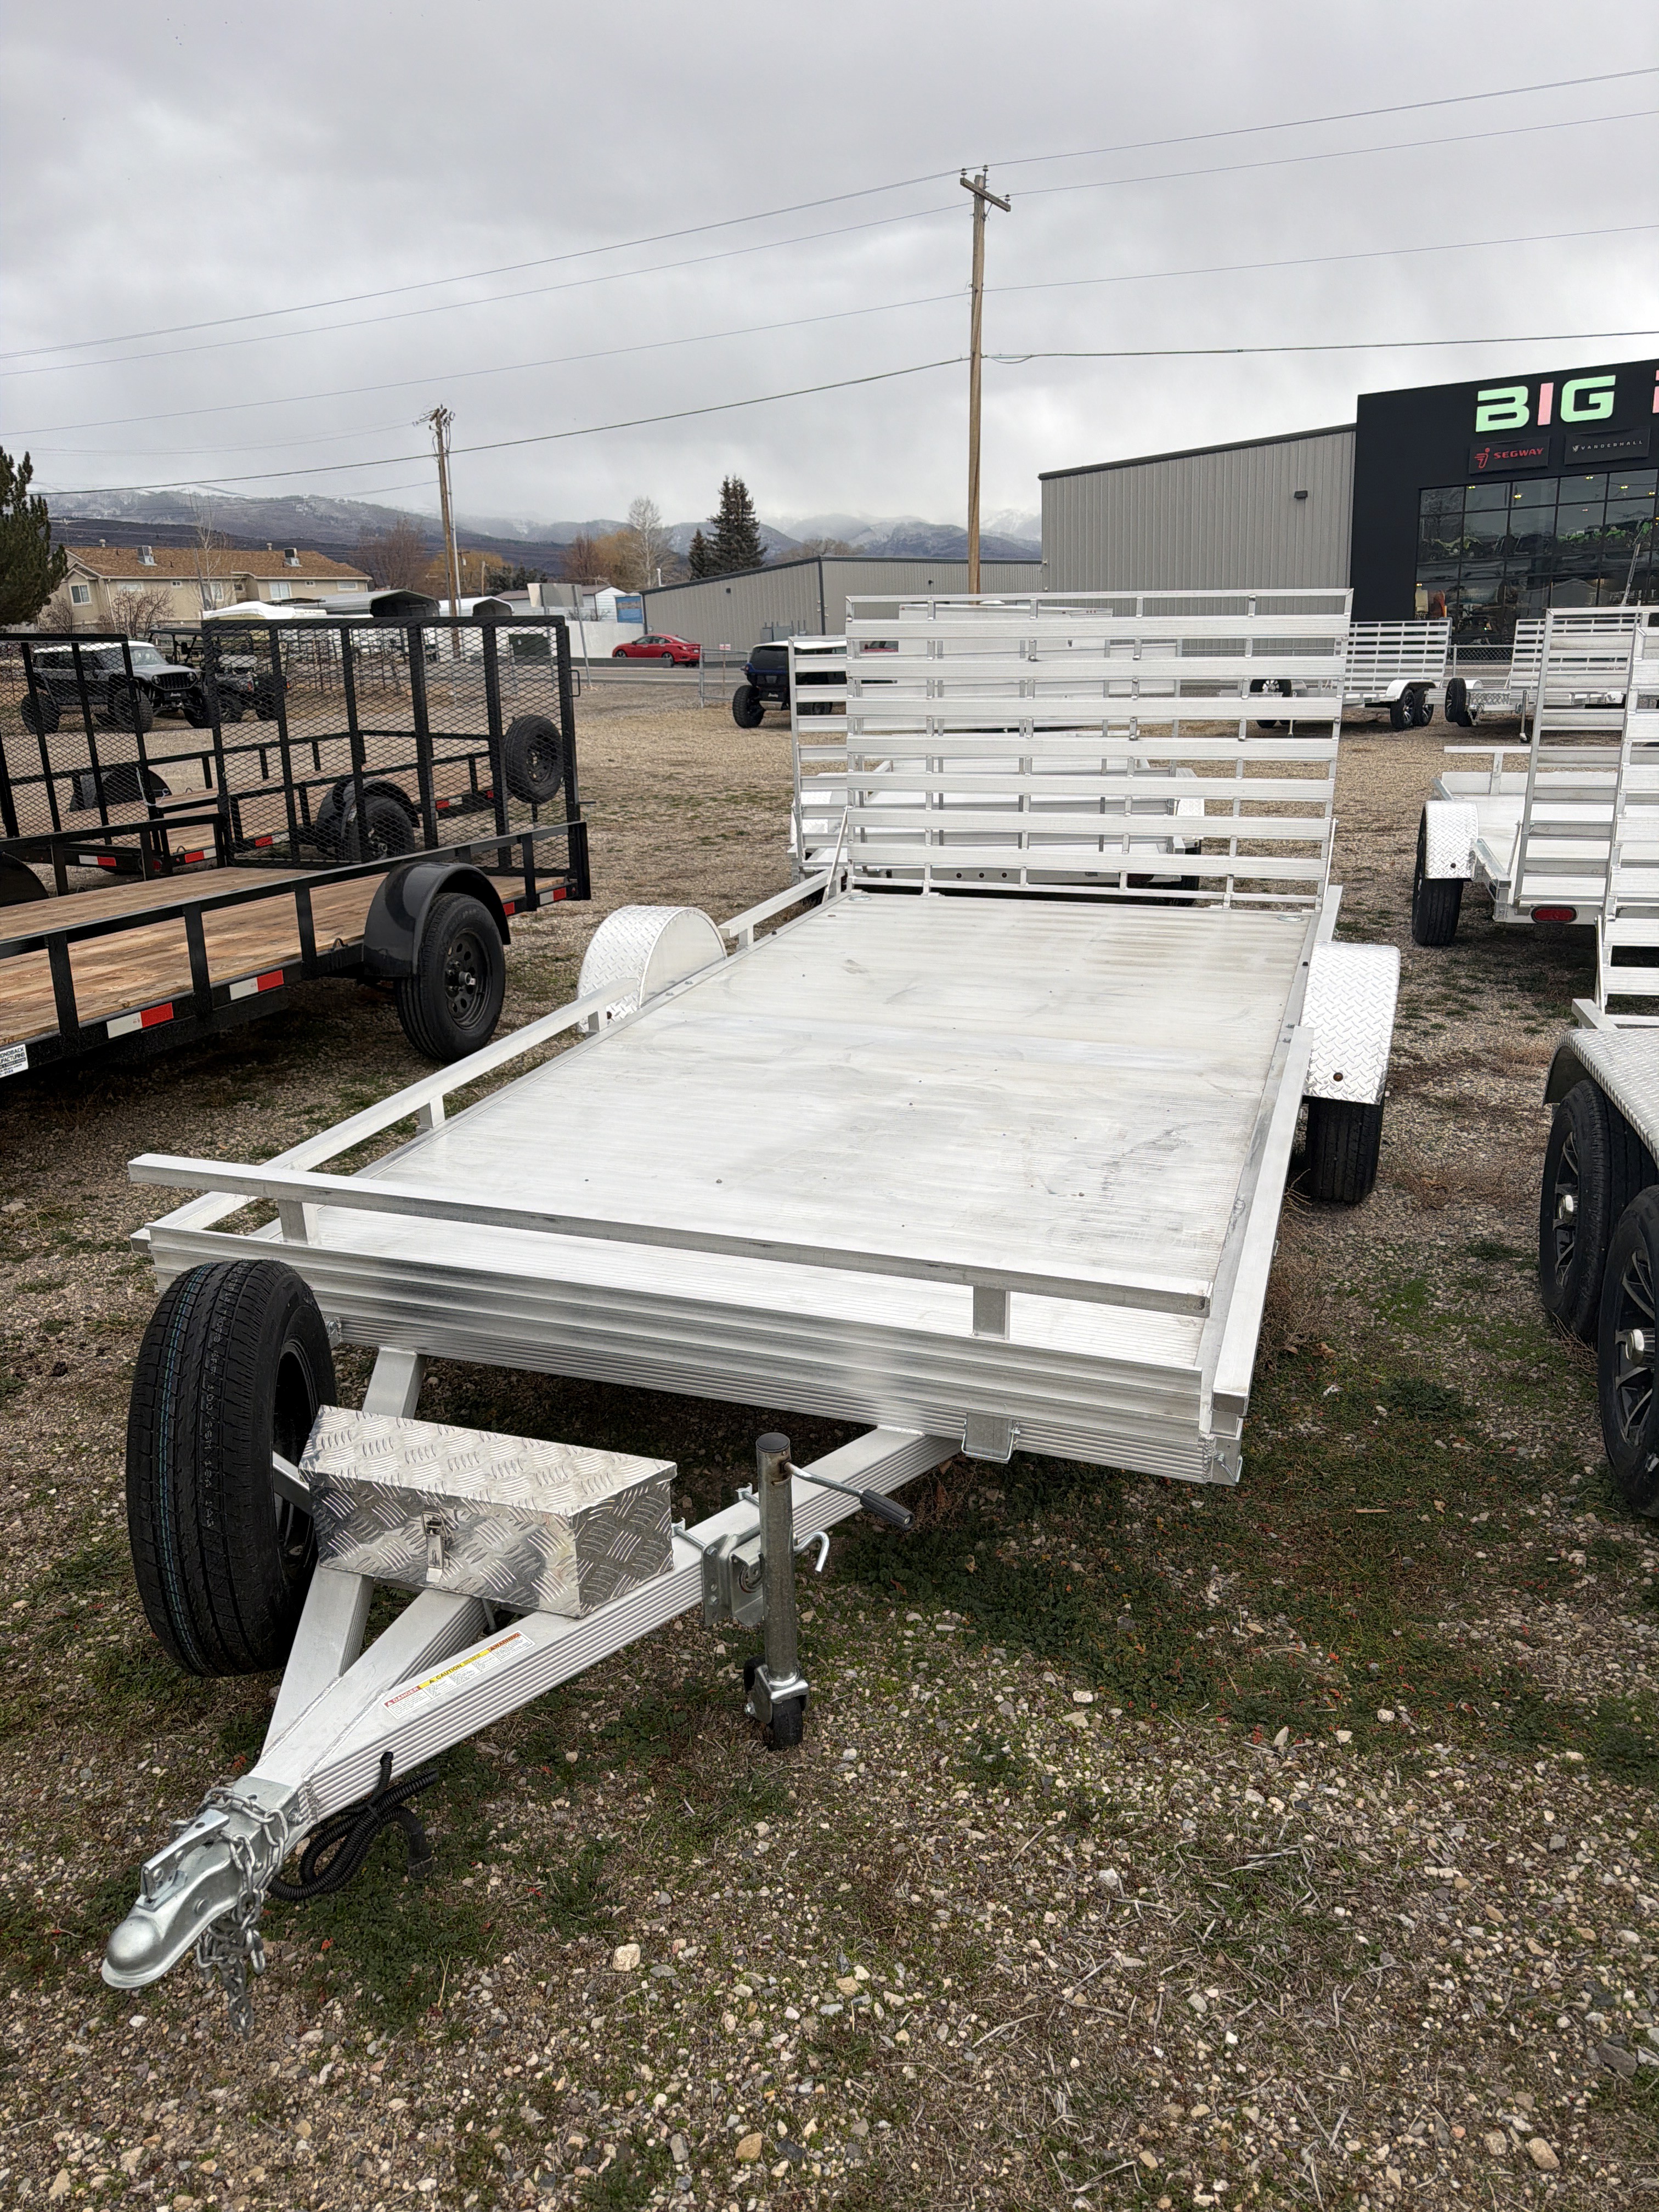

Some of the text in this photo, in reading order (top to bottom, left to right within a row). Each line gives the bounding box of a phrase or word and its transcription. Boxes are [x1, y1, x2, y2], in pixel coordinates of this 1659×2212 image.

[1476, 375, 1616, 432] BIG
[1581, 440, 1643, 450] VANDERHALL
[1493, 448, 1543, 459] SEGWAY
[0, 1046, 24, 1058] ONDBACK
[493, 1632, 521, 1649] WARNING
[436, 1664, 462, 1679] CAUTION
[392, 1687, 419, 1703] DANGER
